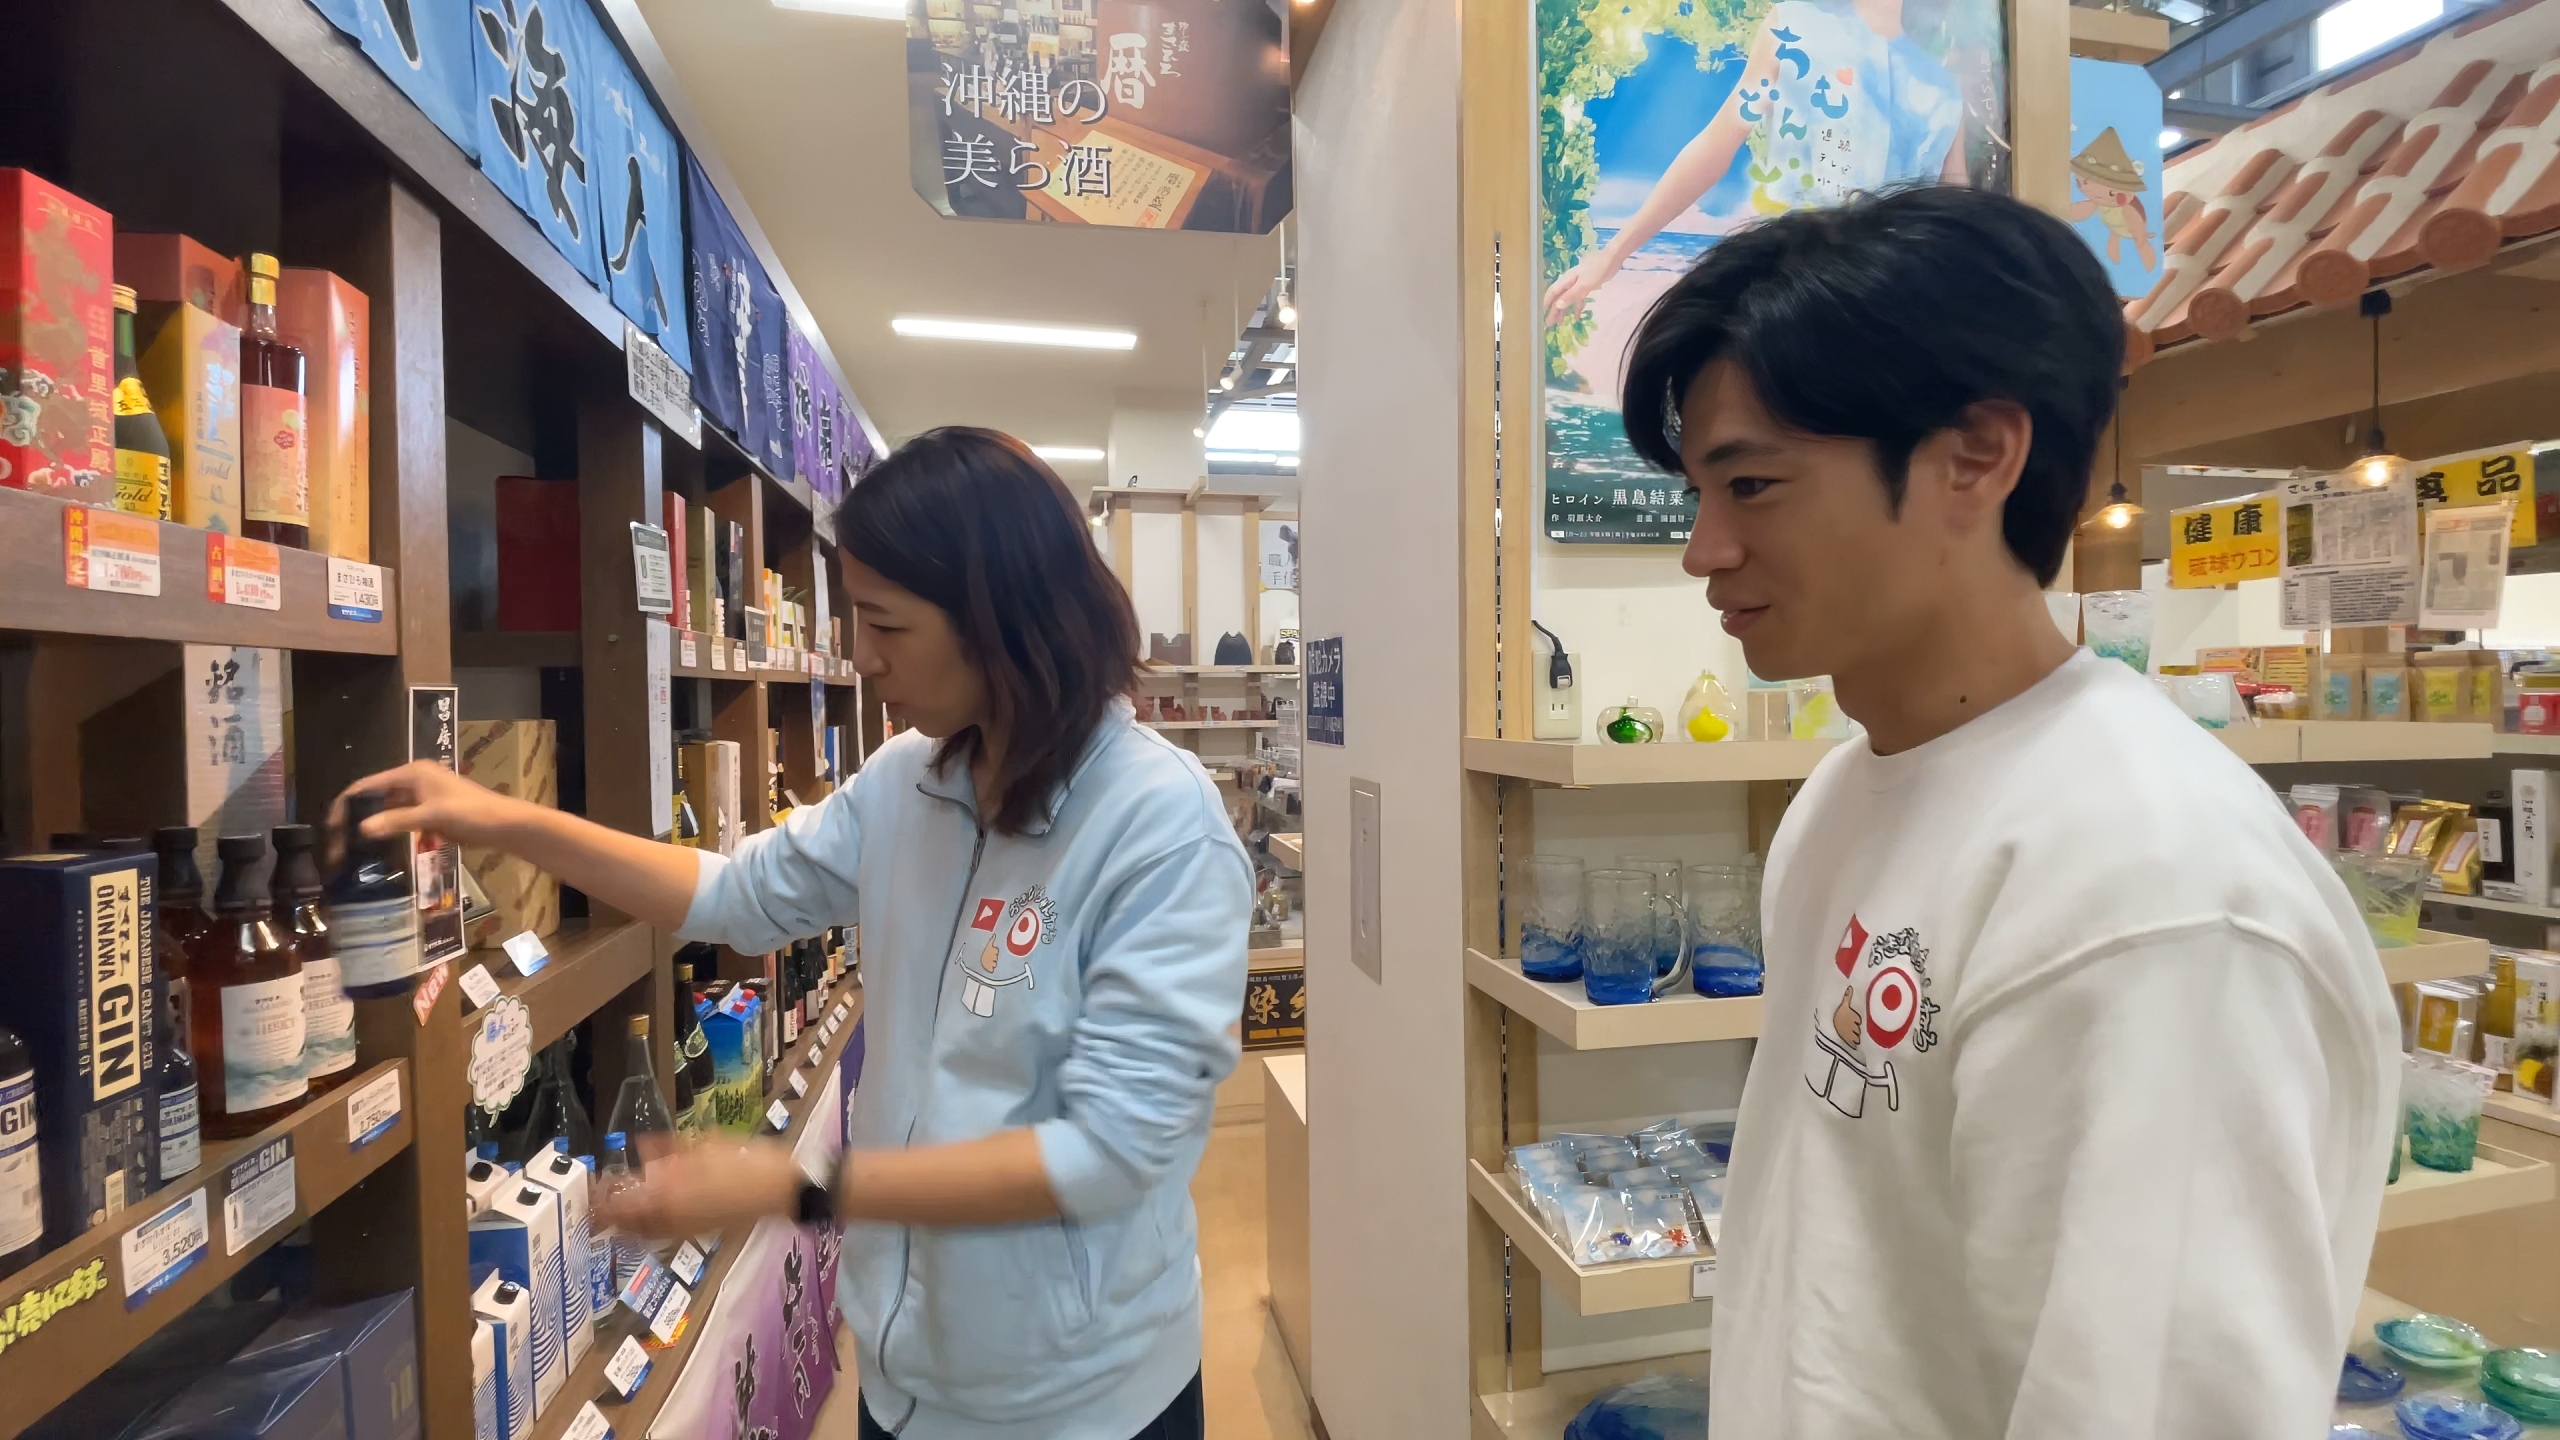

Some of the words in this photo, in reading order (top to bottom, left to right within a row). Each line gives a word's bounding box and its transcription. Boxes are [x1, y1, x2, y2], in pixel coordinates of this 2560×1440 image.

[940, 62, 1109, 125] 沖縄の
[1101, 32, 1157, 110] 暦
[942, 132, 1114, 198] 美ら酒
[1552, 493, 1604, 505] ヒロイン
[1612, 488, 1684, 506] 黒島結菜
[2183, 503, 2263, 545] 健康
[2188, 546, 2279, 577] 琉球ウコン
[96, 884, 116, 984] OKINAWA
[98, 983, 135, 1088] GIN
[258, 1138, 287, 1172] GIN
